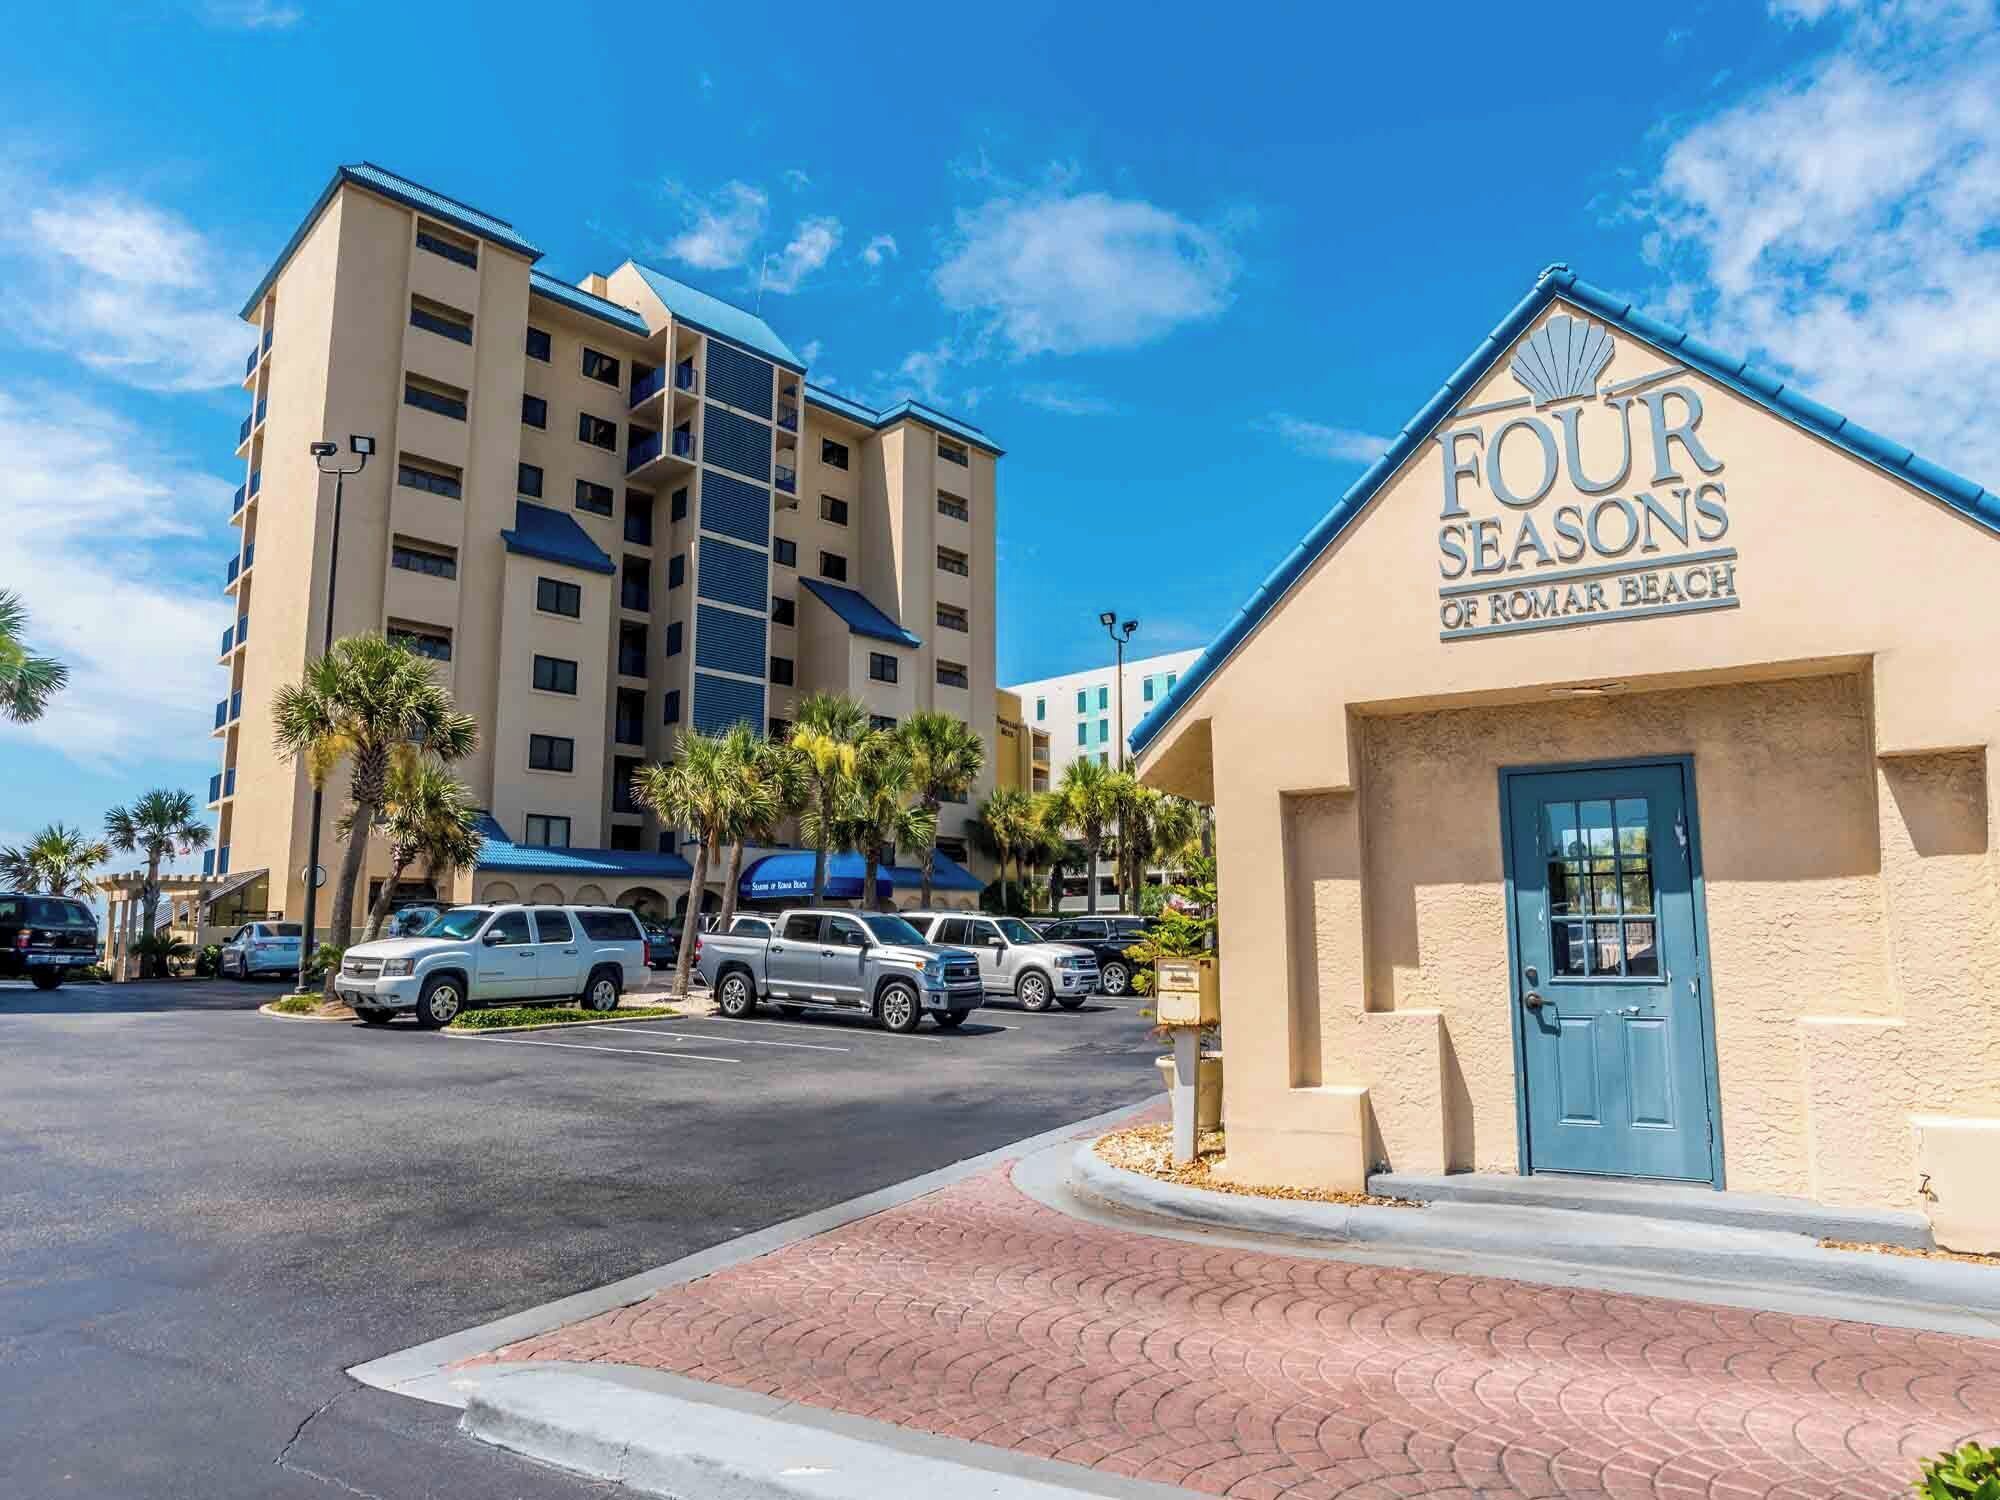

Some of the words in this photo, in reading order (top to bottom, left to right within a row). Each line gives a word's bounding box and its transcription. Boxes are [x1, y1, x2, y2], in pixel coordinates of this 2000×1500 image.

[1435, 386, 1725, 520] FOUR
[1438, 482, 1729, 580] SEASONS
[1440, 599, 1478, 629] OF
[1488, 583, 1608, 624] ROMAR
[1618, 563, 1736, 606] BEACH
